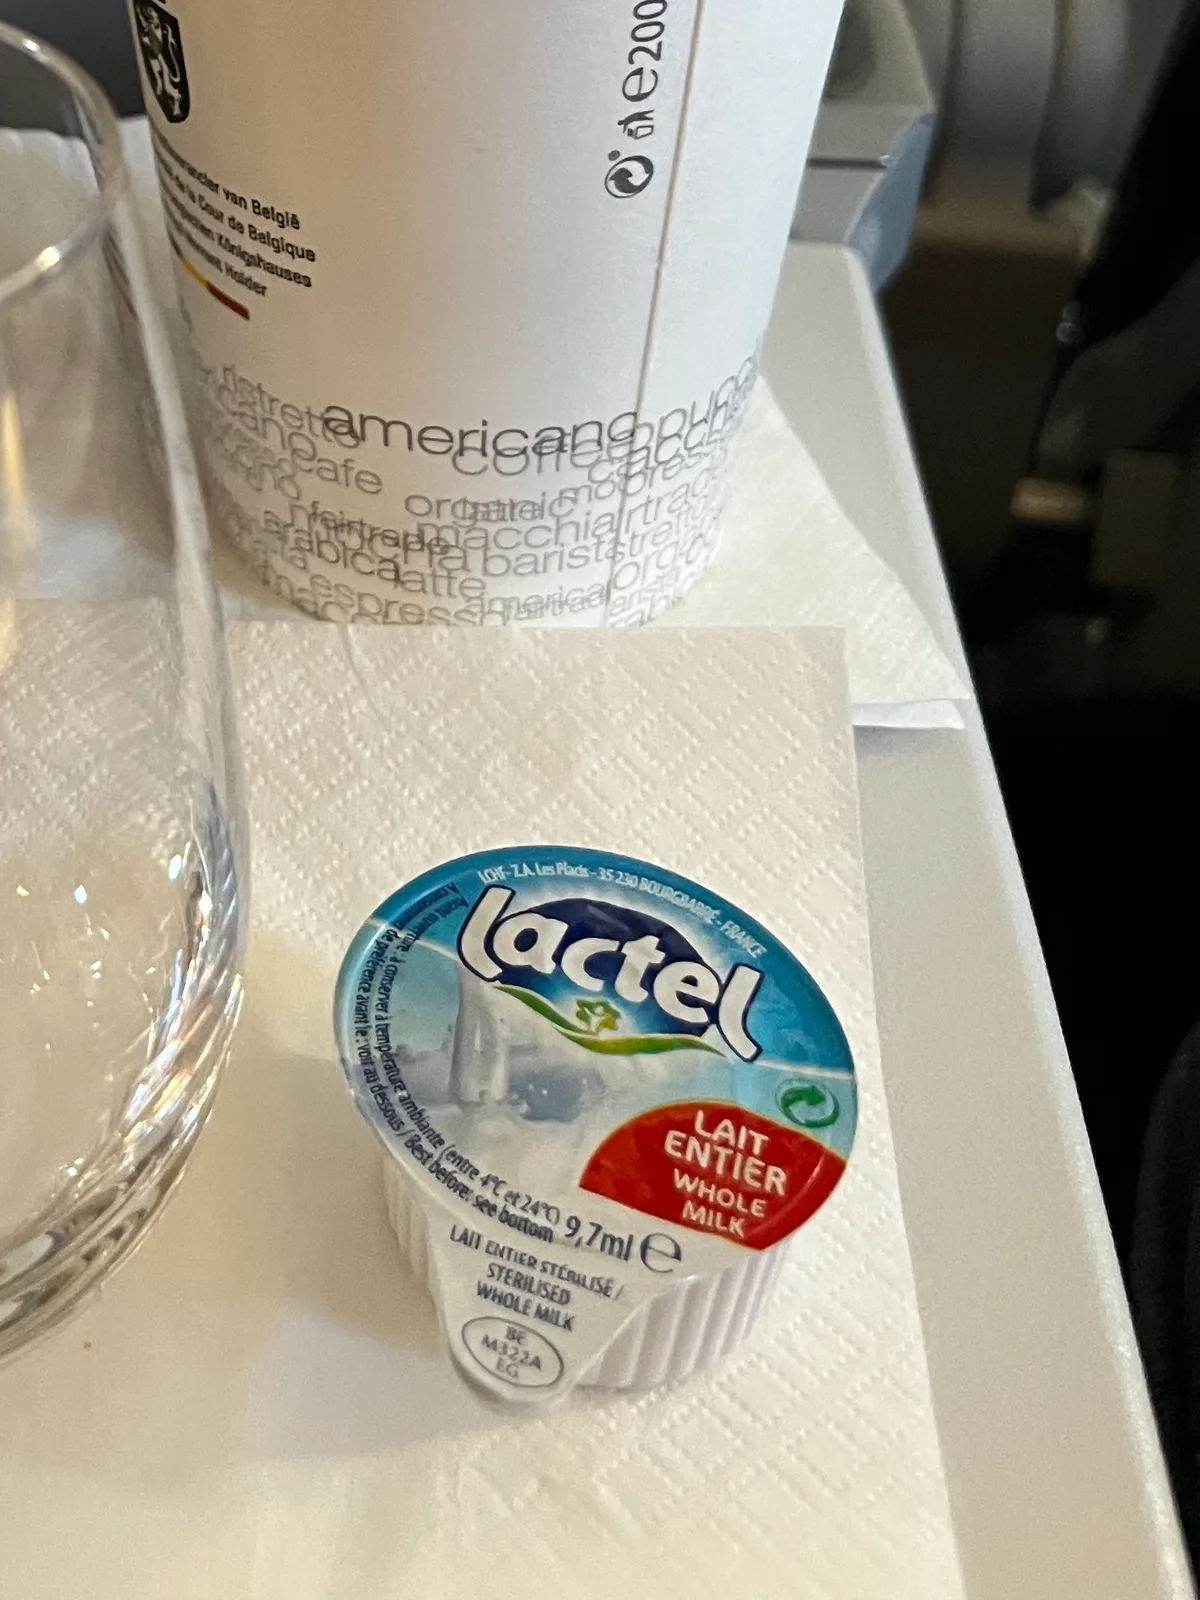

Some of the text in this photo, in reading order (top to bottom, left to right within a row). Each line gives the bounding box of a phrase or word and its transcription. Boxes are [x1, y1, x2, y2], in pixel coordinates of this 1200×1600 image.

[223, 187, 301, 230] van België
[228, 215, 245, 235] de
[248, 224, 316, 262] Belgique
[323, 405, 638, 458] americano
[535, 863, 555, 876] Les
[598, 866, 614, 881] 35
[615, 870, 638, 889] 230
[720, 920, 768, 959] FRANCE
[374, 964, 399, 1014] conserver
[457, 885, 765, 1063] lactel
[354, 994, 370, 1024] avant
[363, 1067, 380, 1084] au
[373, 1022, 407, 1093] température
[370, 1085, 406, 1131] dessous
[398, 1091, 446, 1150] ambiante
[404, 1133, 434, 1166] Best
[694, 1109, 770, 1156] LAIT
[437, 1144, 480, 1180] (entre
[664, 1129, 788, 1197] ENTIER
[472, 1194, 498, 1217] see
[503, 1190, 521, 1207] et
[673, 1167, 767, 1218] WHOLE
[498, 1204, 553, 1243] bottom
[564, 1215, 635, 1262] 9,7ml
[682, 1199, 747, 1239] MILK
[450, 1224, 482, 1250] LAIT
[484, 1239, 539, 1270] ENTIER
[476, 1280, 576, 1332] WHOLE MILK
[486, 1262, 571, 1306] STERILISED
[505, 1325, 527, 1345] BE
